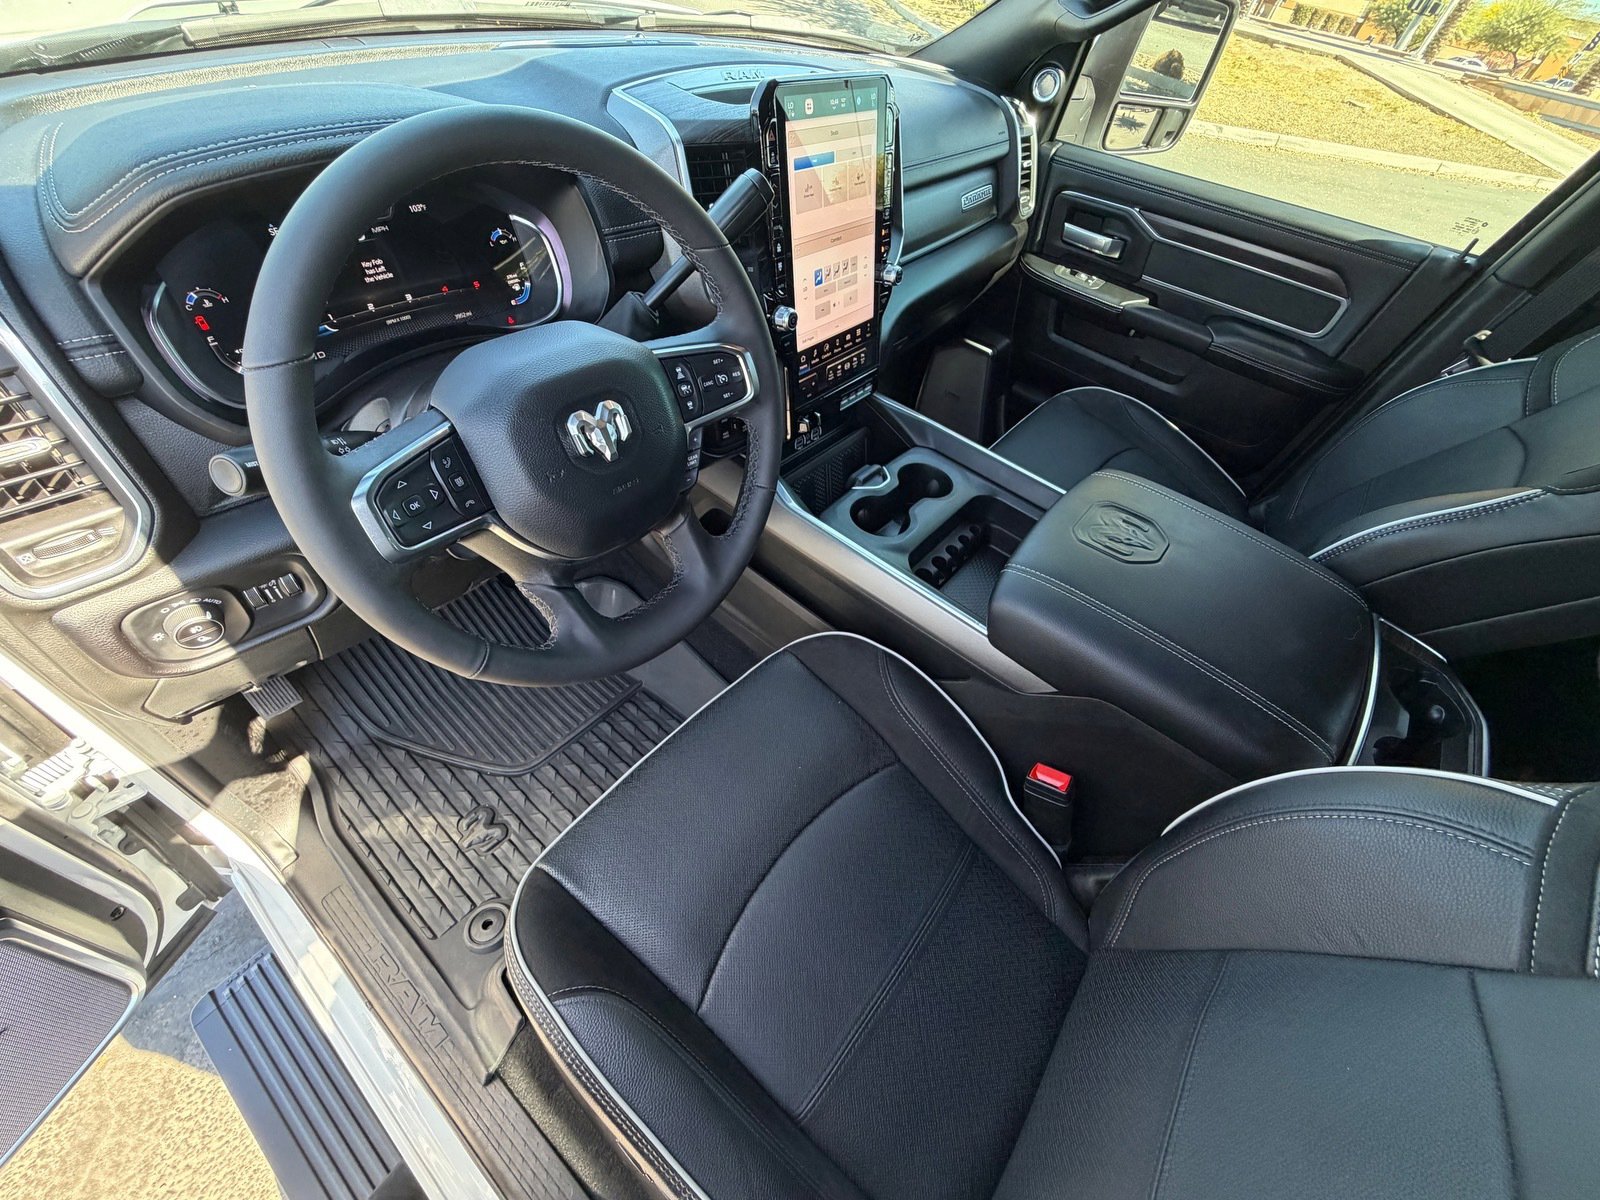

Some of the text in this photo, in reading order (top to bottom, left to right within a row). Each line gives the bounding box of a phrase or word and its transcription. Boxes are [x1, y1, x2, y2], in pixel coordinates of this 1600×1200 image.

[723, 69, 765, 81] RAM
[371, 225, 389, 233] MPH
[375, 265, 386, 273] Left
[374, 272, 393, 280] Vehicle
[703, 380, 714, 388] CANC
[409, 501, 420, 511] OK
[373, 942, 450, 1049] RAM
